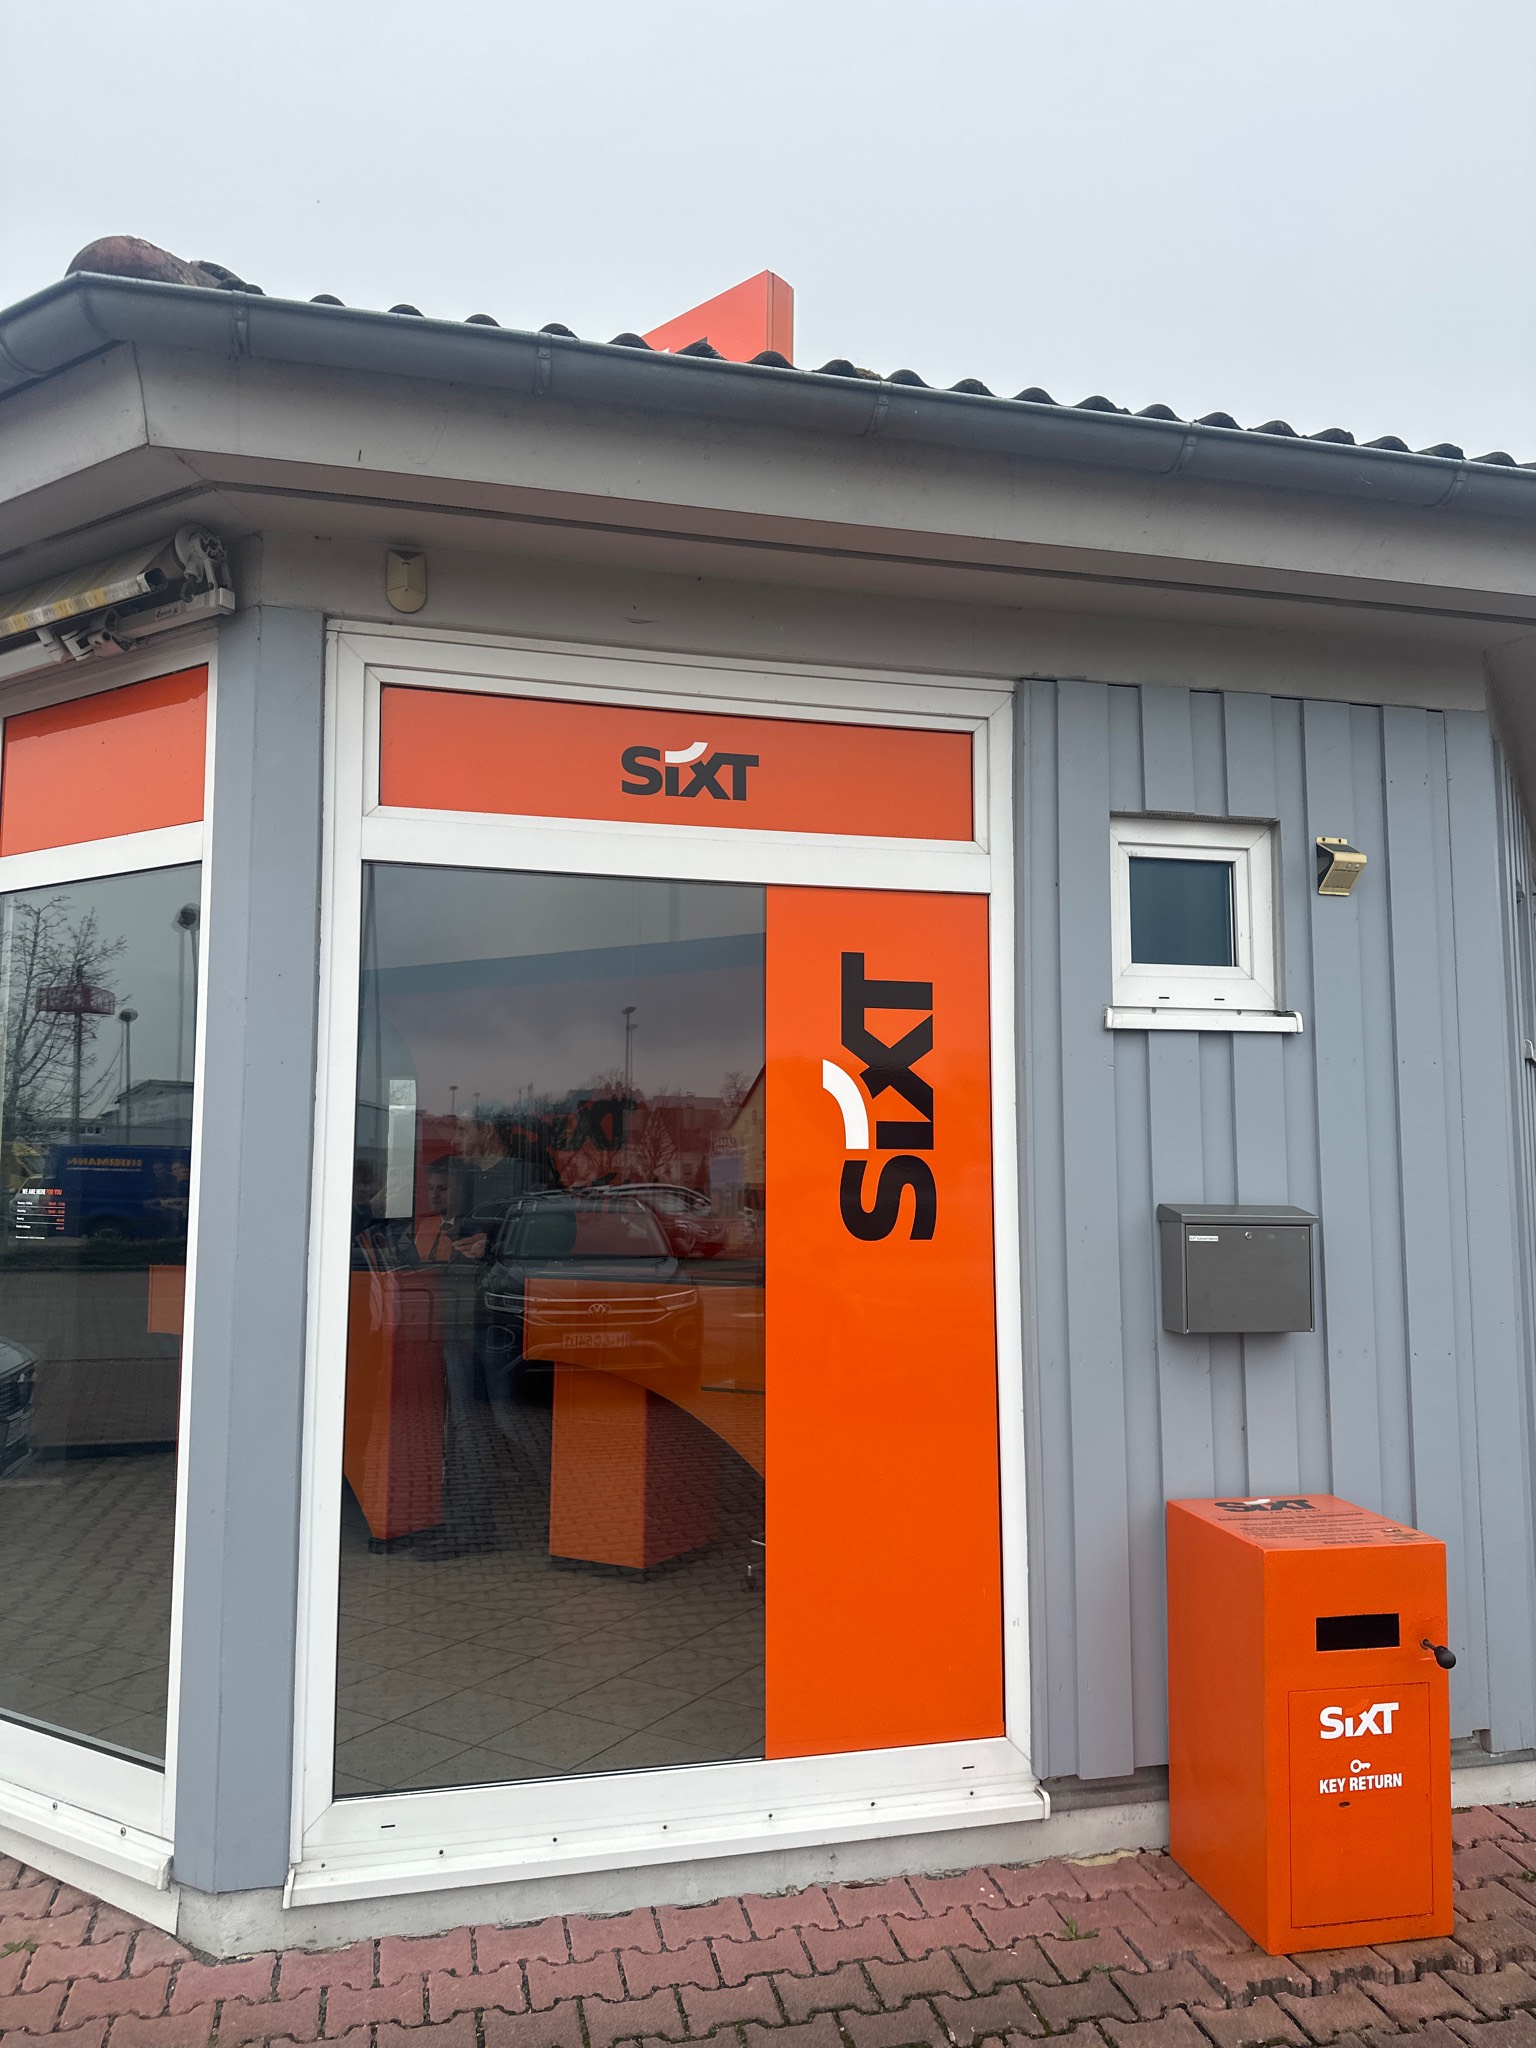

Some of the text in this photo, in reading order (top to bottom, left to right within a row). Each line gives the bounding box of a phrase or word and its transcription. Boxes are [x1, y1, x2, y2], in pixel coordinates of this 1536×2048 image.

[621, 741, 760, 802] SIXT
[822, 951, 938, 1242] SIXT
[1215, 1499, 1317, 1513] SIXT
[1319, 1702, 1399, 1740] SIXT
[1319, 1772, 1403, 1794] KEY RETURN
